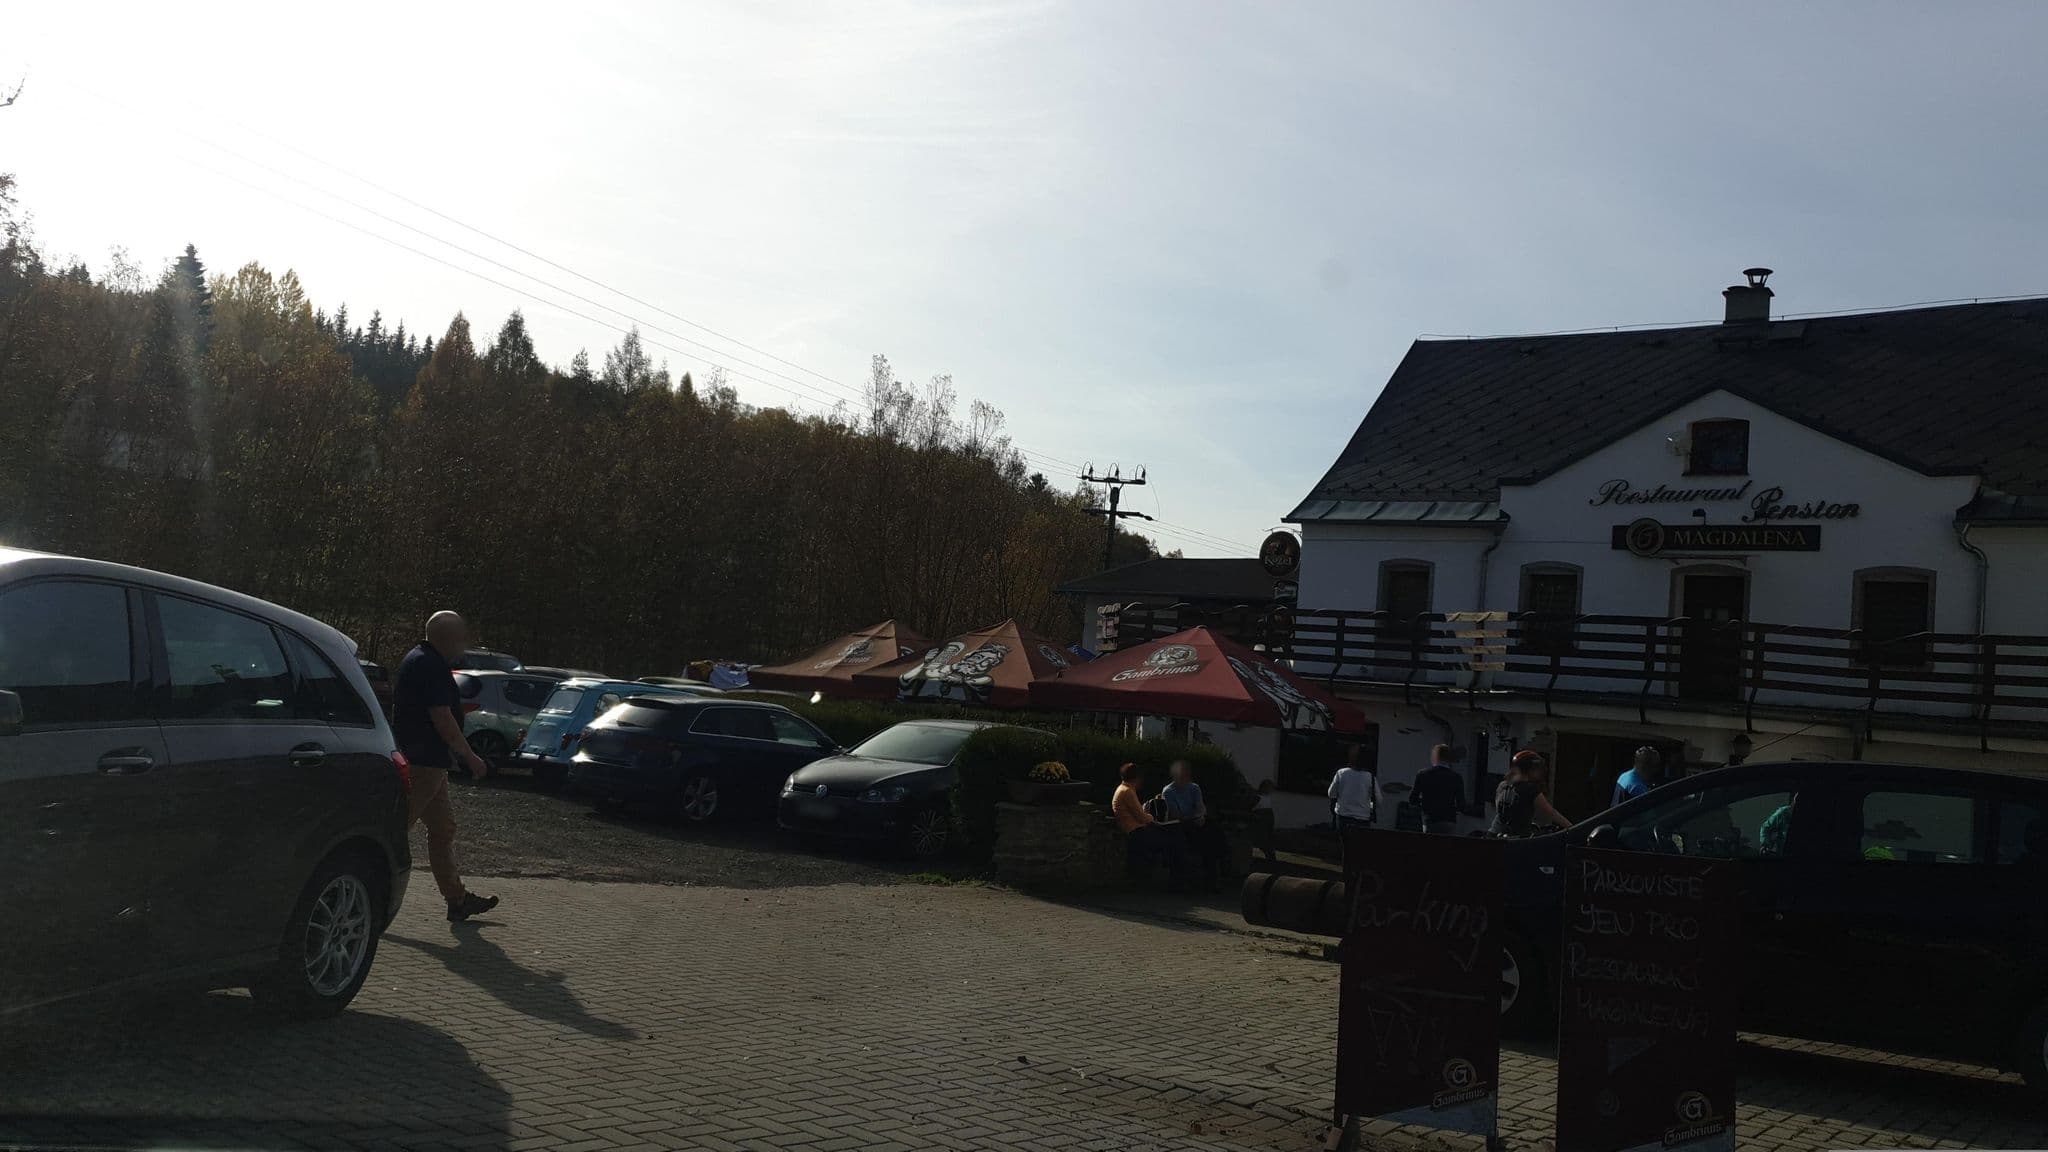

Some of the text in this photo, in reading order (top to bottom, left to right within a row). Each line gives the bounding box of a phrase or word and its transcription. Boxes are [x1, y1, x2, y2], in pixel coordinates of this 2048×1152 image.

[1590, 479, 1752, 506] Restaurant
[1742, 486, 1860, 523] Pension
[1673, 529, 1808, 546] MAGDALENA
[1111, 664, 1200, 682] Gambrinus
[1347, 869, 1488, 974] Parking
[1645, 909, 1701, 941] PRO
[1432, 1087, 1488, 1108] Gambrinus
[1664, 1122, 1722, 1146] Gambrinus
